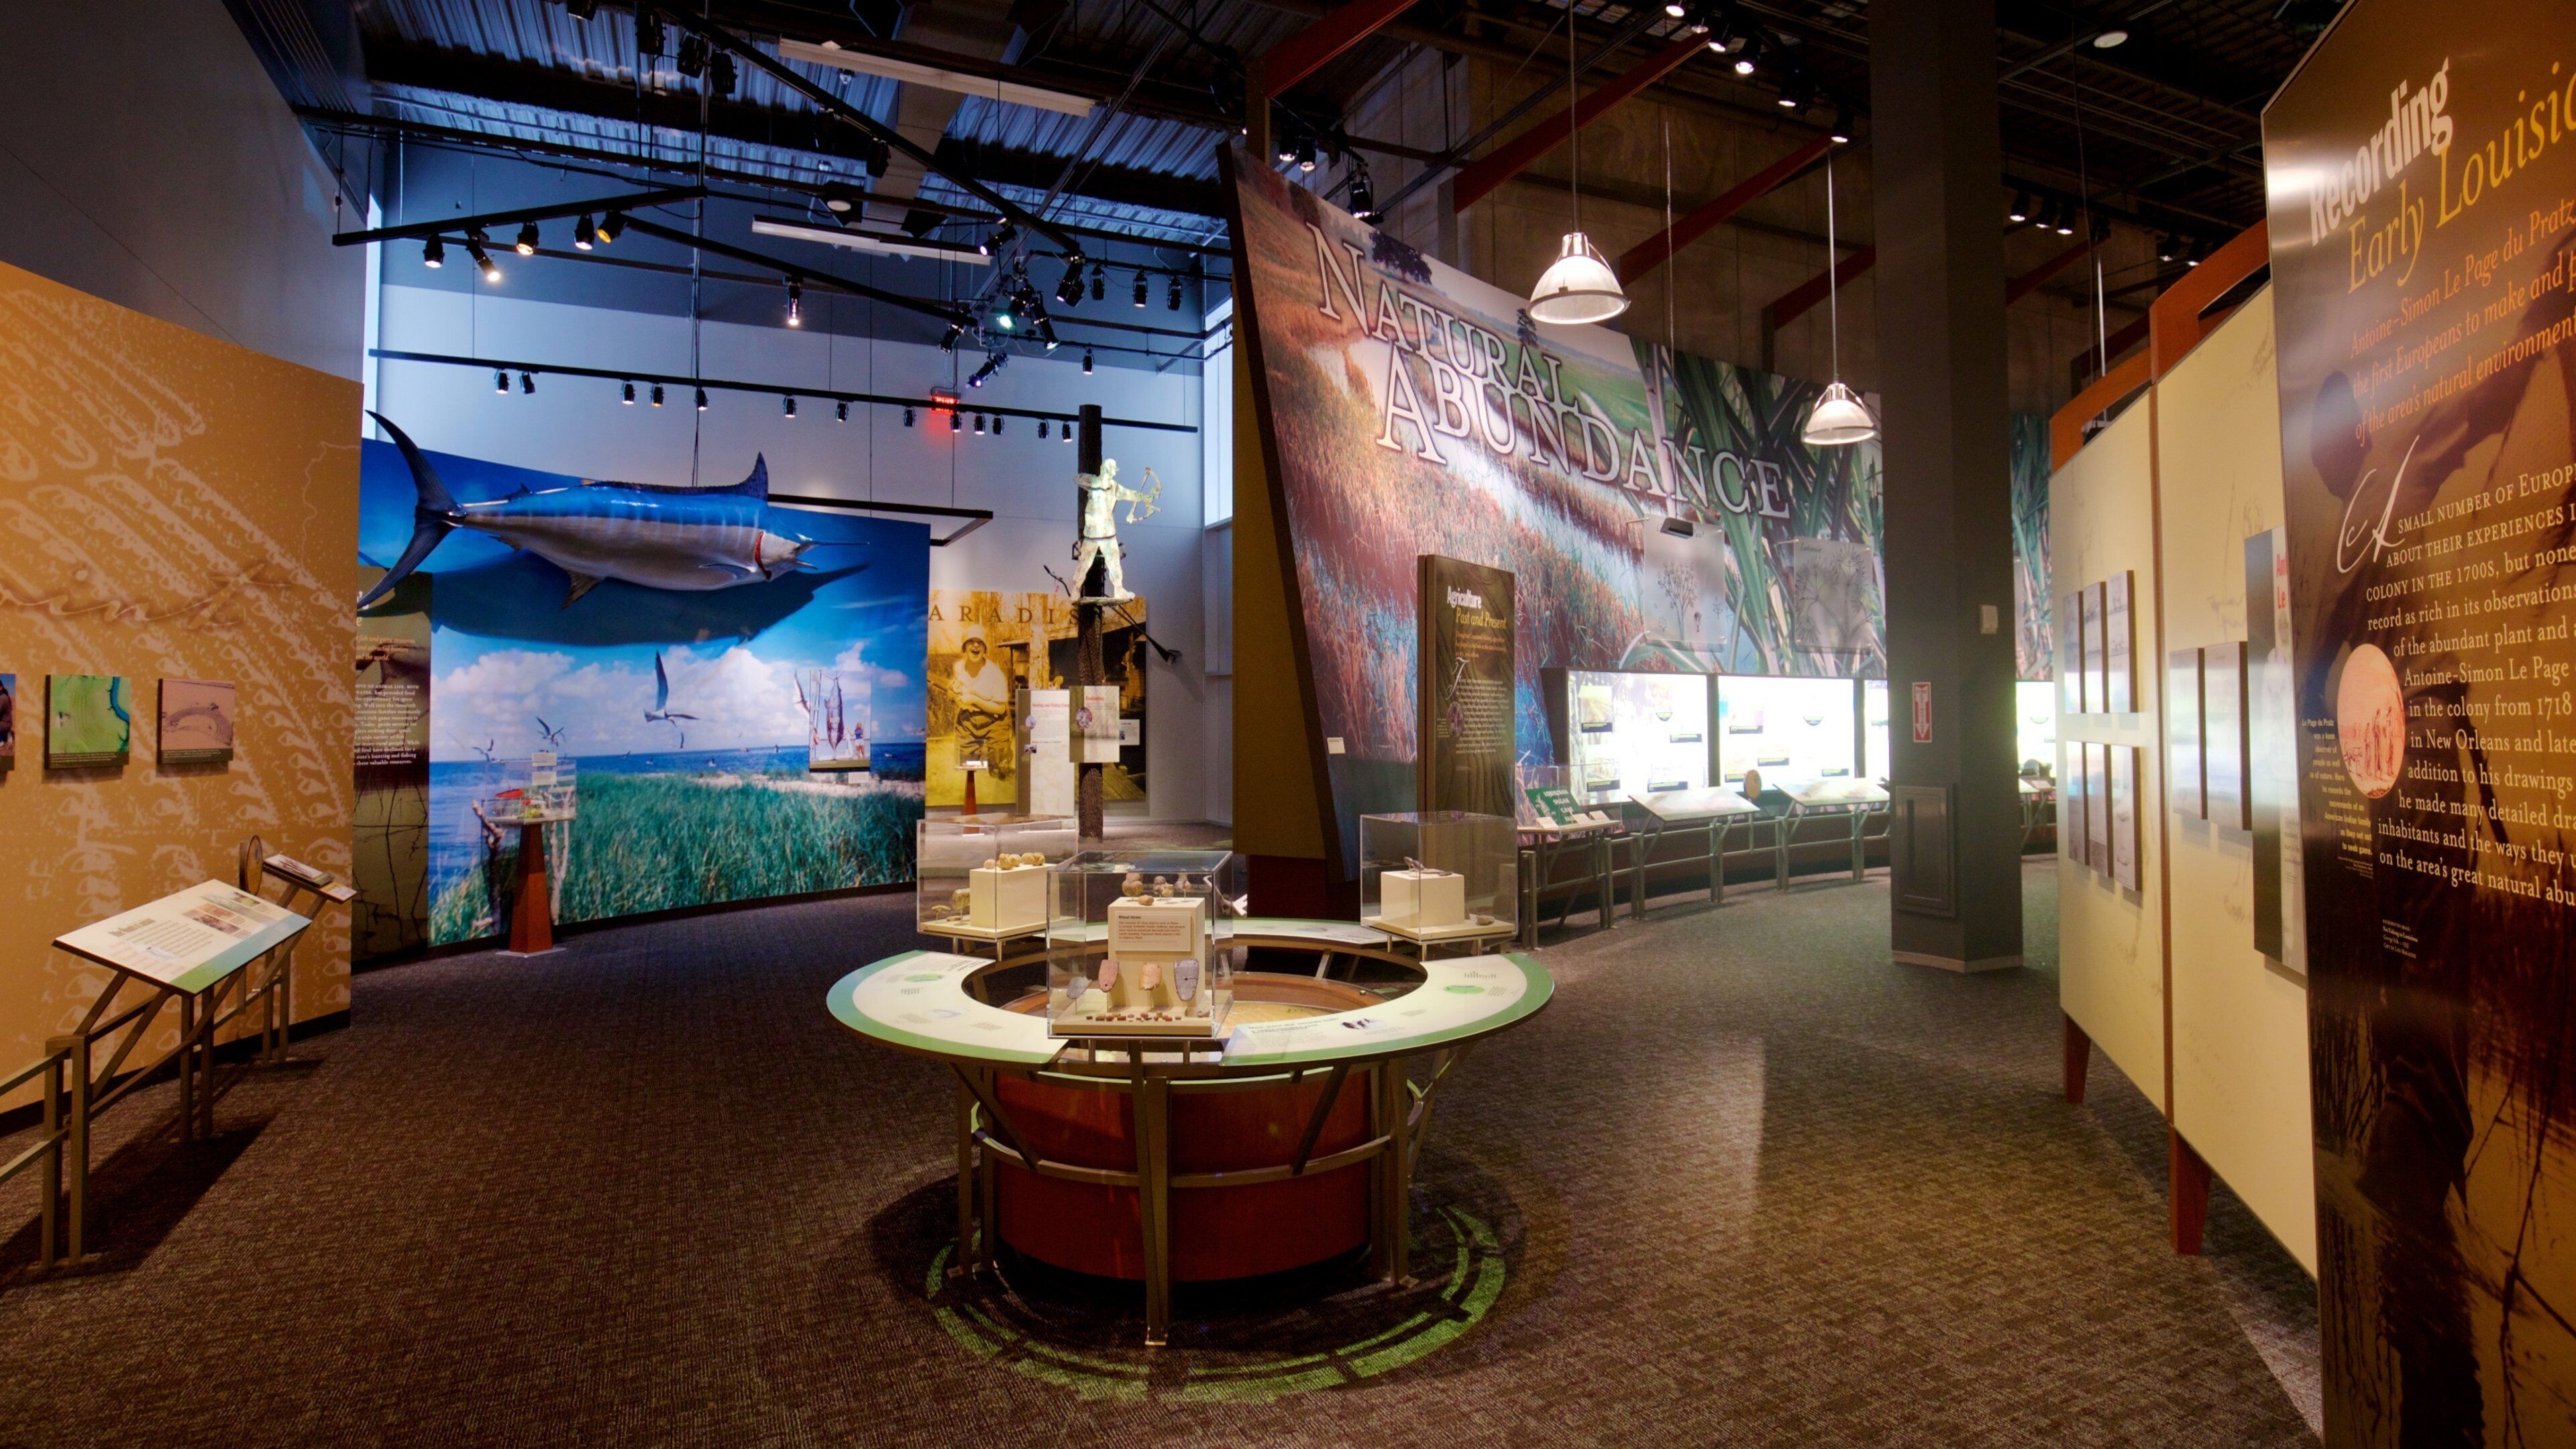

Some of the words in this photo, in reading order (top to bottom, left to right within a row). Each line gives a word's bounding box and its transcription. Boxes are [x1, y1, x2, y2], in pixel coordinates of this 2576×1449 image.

[2310, 57, 2453, 247] Recording
[2348, 179, 2424, 294] Early
[2351, 288, 2440, 358] Antoine-Simon
[2444, 270, 2461, 300] Le
[2465, 250, 2498, 287] Page
[2504, 227, 2523, 262] du
[2528, 199, 2576, 247] Pratz
[1305, 221, 1580, 414] NATURAL
[2353, 367, 2368, 399] the
[2370, 358, 2392, 399] first
[2396, 322, 2462, 375] Europeans
[2465, 311, 2480, 336] to
[2485, 281, 2524, 326] make
[2530, 250, 2564, 301] and
[2355, 408, 2367, 447] of
[2368, 405, 2384, 433] the
[2387, 384, 2420, 424] area's
[2423, 357, 2472, 407] natural
[2476, 307, 2576, 380] environment
[1376, 345, 1791, 519] ABUNDANCE
[2398, 510, 2434, 534] SMALL
[2437, 492, 2491, 522] NUMBER
[2495, 484, 2514, 504] OF
[2518, 464, 2576, 498] EUROP
[2386, 545, 2422, 568] ABOUT
[2425, 534, 2463, 557] THEIR
[2467, 506, 2563, 547] EXPERIENCES
[1447, 586, 1482, 609] Agriculture
[2366, 580, 2408, 602] COLONY
[2412, 576, 2424, 593] IN
[2428, 570, 2453, 589] THE
[2504, 552, 2530, 574] but
[2534, 545, 2576, 568] none
[928, 605, 1107, 625] ARADIS
[1456, 606, 1470, 624] Past
[1470, 611, 1484, 626] and
[1485, 611, 1507, 629] Present
[2367, 607, 2402, 631] record
[2405, 612, 2416, 626] as
[2419, 600, 2443, 623] rich
[2447, 601, 2460, 618] in
[2464, 597, 2479, 616] its
[2483, 582, 2576, 613] observations
[2394, 638, 2406, 657] of
[2407, 636, 2426, 655] the
[2429, 629, 2489, 654] abundant
[2494, 623, 2532, 654] plant
[2538, 615, 2568, 641] and
[2404, 661, 2505, 686] Antoine-Simon
[2508, 657, 2528, 680] Le
[2532, 656, 2570, 686] Page
[2409, 698, 2421, 717] in
[2424, 697, 2444, 717] the
[2447, 696, 2491, 724] colony
[2495, 694, 2532, 716] from
[2536, 691, 2573, 722] 1718
[2410, 731, 2422, 749] in
[2426, 729, 2452, 749] New
[2456, 729, 2510, 751] Orleans
[2515, 729, 2544, 753] and
[2408, 759, 2459, 782] addition
[2462, 767, 2475, 784] to
[2479, 763, 2500, 786] his
[2504, 765, 2573, 799] drawings
[2398, 789, 2412, 809] he
[2415, 792, 2447, 814] made
[2450, 801, 2484, 826] many
[2488, 798, 2548, 826] detailed
[2378, 817, 2440, 845] inhabitants
[2443, 828, 2467, 849] and
[2470, 830, 2491, 853] the
[2495, 841, 2527, 866] ways
[2531, 839, 2565, 875] they
[2379, 851, 2394, 865] on
[2396, 849, 2414, 870] the
[2416, 857, 2448, 878] area's
[2451, 865, 2483, 888] great
[2487, 875, 2541, 899] natural
